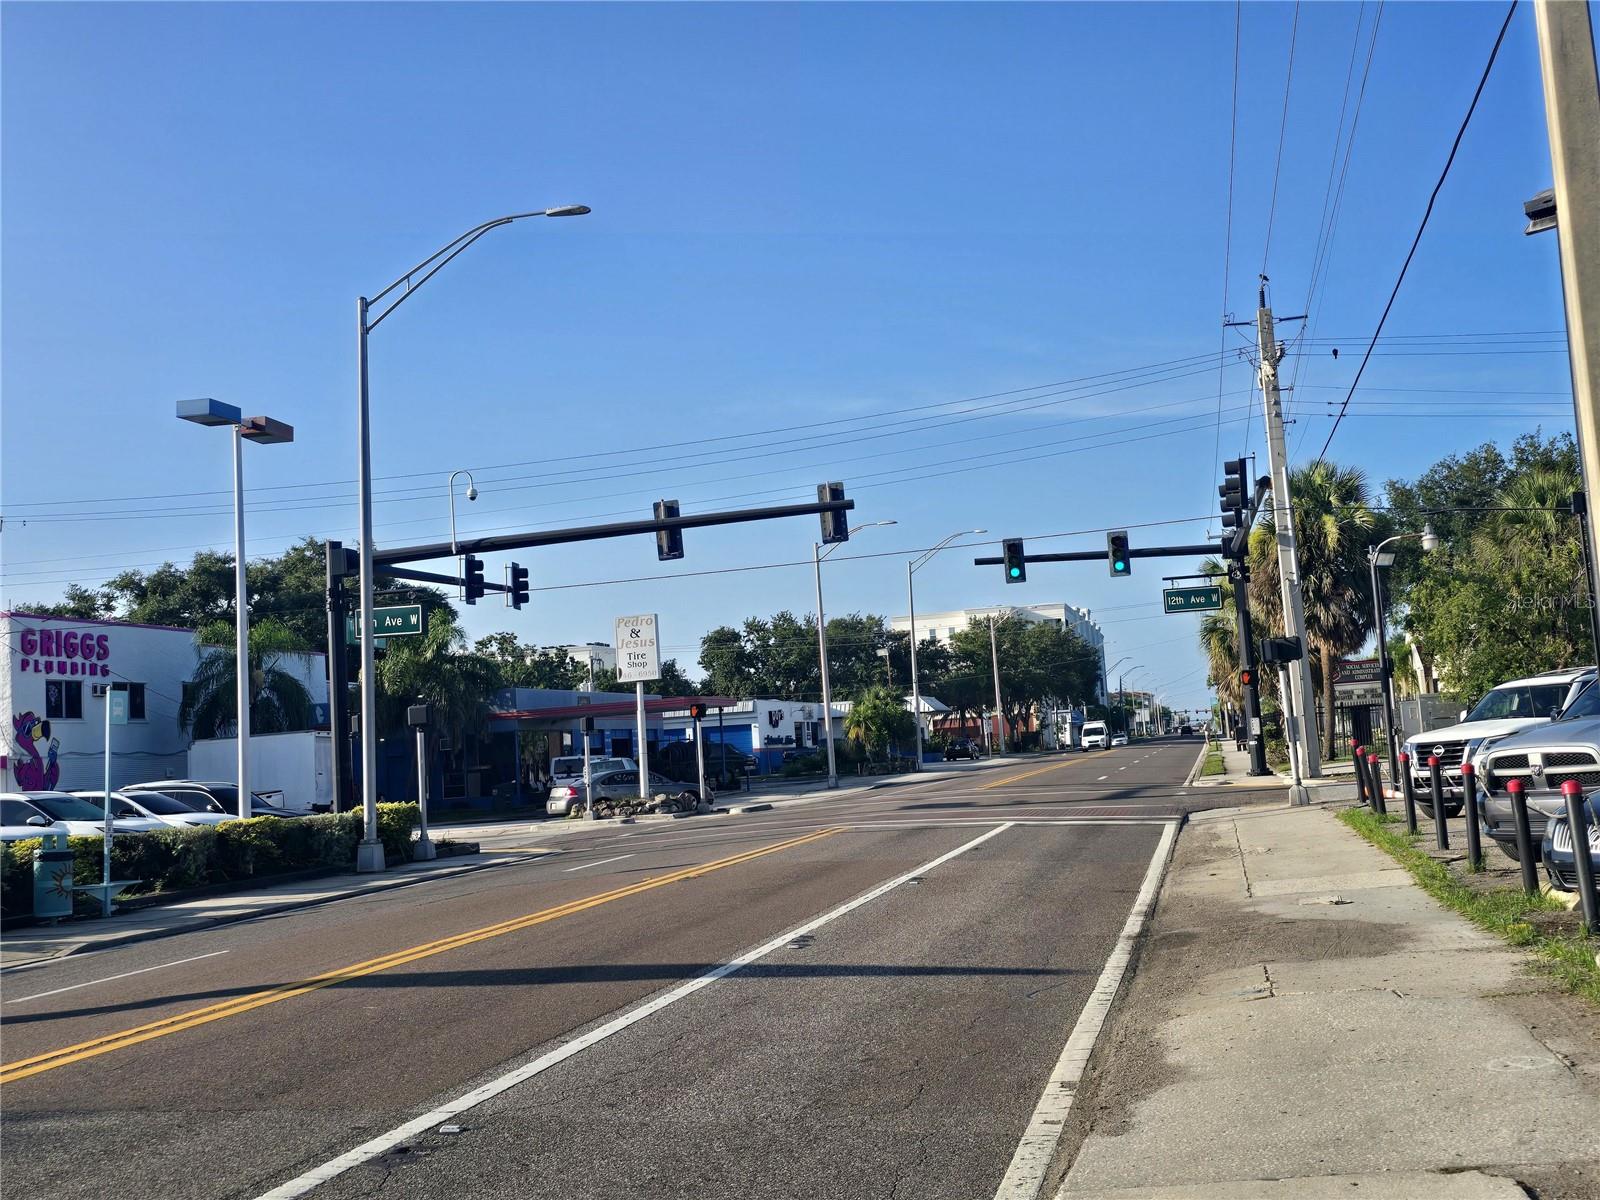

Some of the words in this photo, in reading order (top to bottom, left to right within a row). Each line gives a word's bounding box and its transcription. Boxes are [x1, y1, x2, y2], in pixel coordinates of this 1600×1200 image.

[1168, 596, 1185, 606] 12th
[1190, 595, 1206, 604] Ave
[1211, 593, 1218, 602] W
[384, 616, 403, 627] Ave
[410, 614, 418, 625] W
[617, 616, 654, 628] Pedro
[629, 628, 641, 639] &
[20, 627, 110, 661] GRIGGS
[618, 638, 656, 650] Jesus
[626, 652, 647, 661] Tire
[20, 658, 110, 677] PLUMBING
[626, 661, 648, 669] Shop
